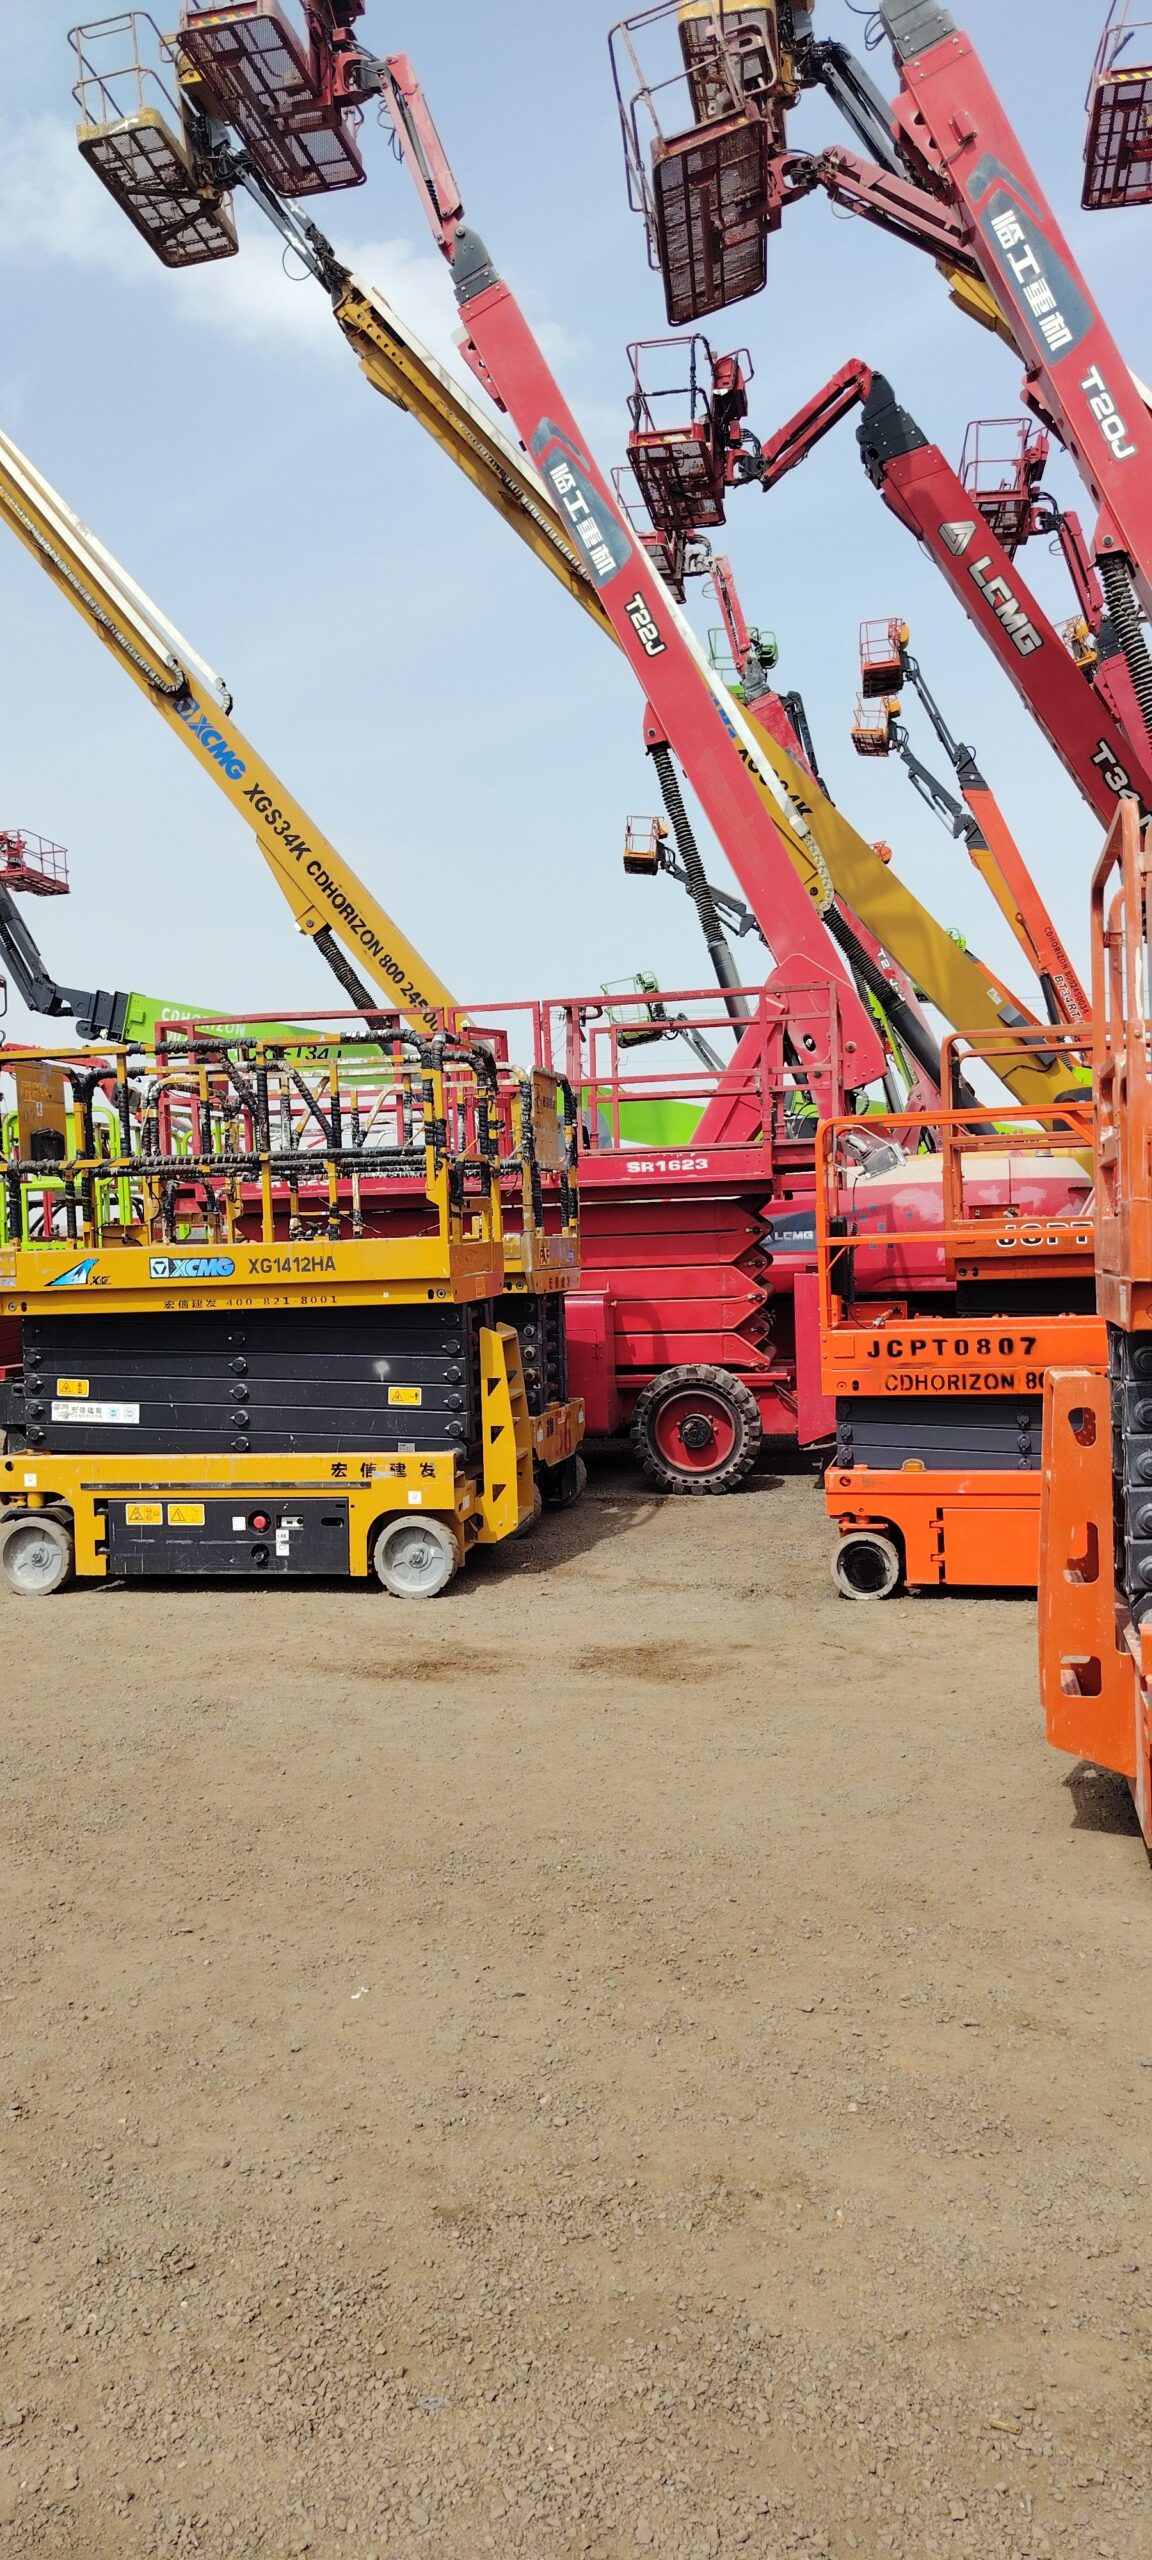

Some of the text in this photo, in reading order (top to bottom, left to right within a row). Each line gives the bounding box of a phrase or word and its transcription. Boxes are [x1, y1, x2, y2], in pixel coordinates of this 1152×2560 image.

[1080, 365, 1136, 460] T20J
[625, 592, 667, 657] T22J
[187, 713, 247, 780] XCMG
[243, 783, 312, 862] XGS34K
[306, 861, 383, 957] CDHORIZON
[378, 954, 406, 985] 800
[1044, 926, 1070, 970] CDHORIZON
[626, 1158, 708, 1173] SR1623
[170, 1255, 336, 1277] XCMG XG1412HA
[226, 1295, 338, 1306] 400-821-8001
[867, 1337, 1037, 1358] JCPT0807
[885, 1372, 1015, 1392] CDHORIZON
